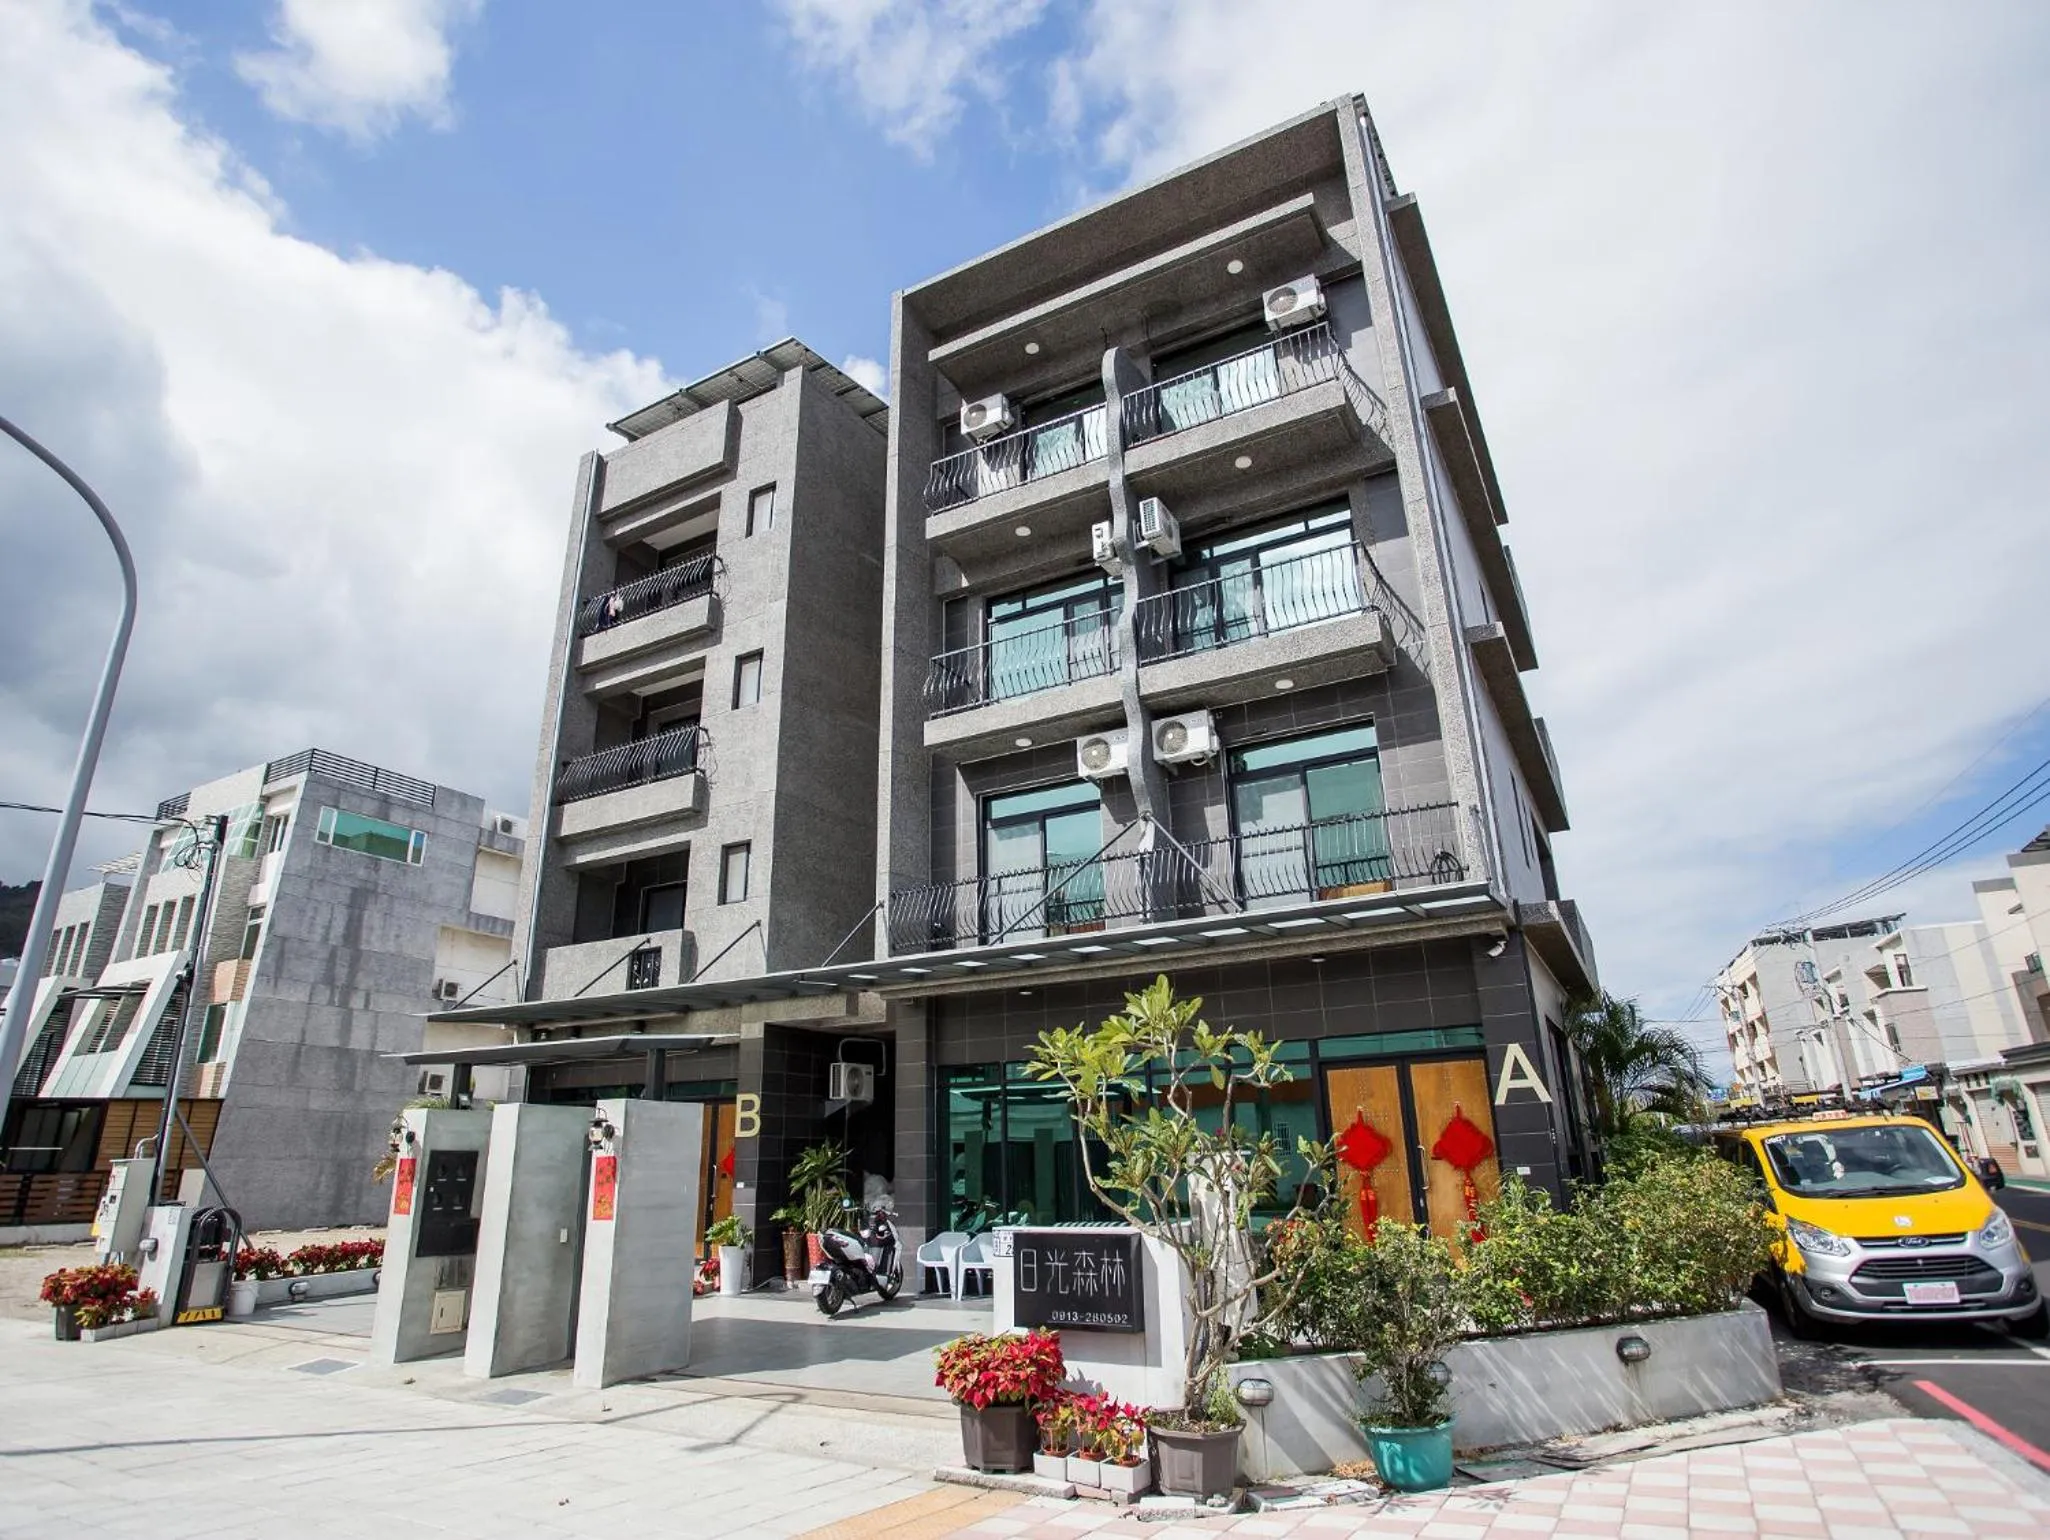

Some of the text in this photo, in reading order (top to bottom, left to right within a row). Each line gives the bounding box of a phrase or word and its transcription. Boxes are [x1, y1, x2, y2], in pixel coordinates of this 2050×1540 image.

[1494, 1043, 1553, 1105] A
[735, 1093, 761, 1138] B
[1020, 1248, 1126, 1297] 日光森林
